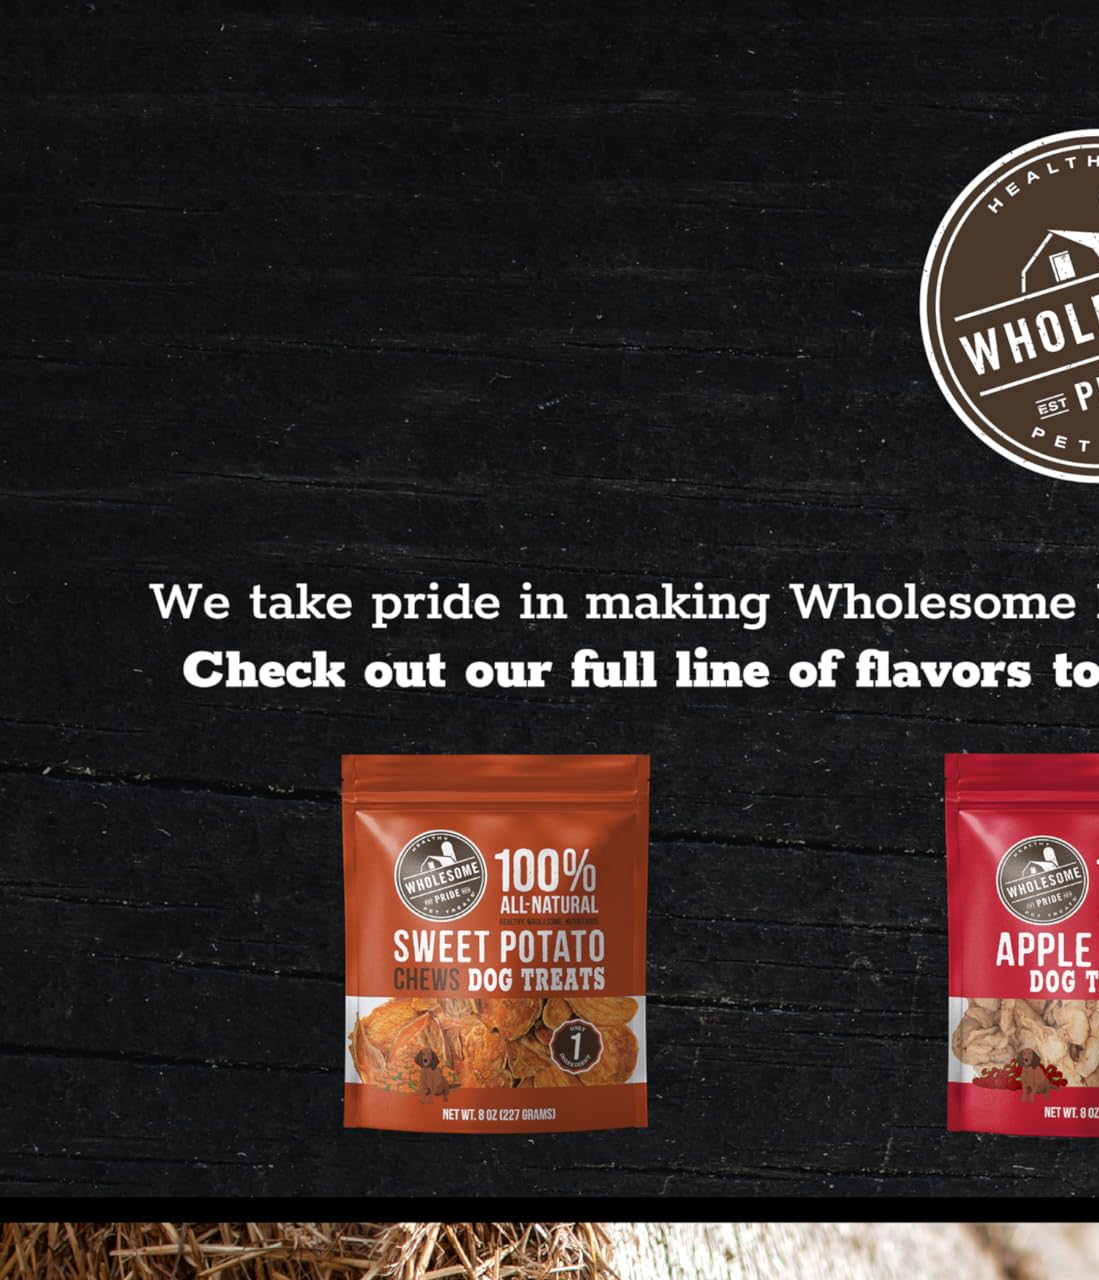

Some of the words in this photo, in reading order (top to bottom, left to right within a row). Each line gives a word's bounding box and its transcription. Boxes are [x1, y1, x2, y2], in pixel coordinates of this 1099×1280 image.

[404, 861, 480, 895] WHOLESOME
[494, 848, 597, 893] 100%
[1006, 866, 1082, 899] WHOLESOME
[433, 888, 462, 904] PRIDE
[500, 895, 599, 915] ALL-NATURAL
[1035, 892, 1063, 908] PRIDE
[393, 929, 490, 963] SWEET
[500, 929, 605, 963] POTATO
[996, 932, 1092, 967] APPLE
[393, 967, 460, 991] CHEWS
[468, 967, 513, 992] DOG
[520, 967, 606, 991] TREATS
[1029, 970, 1076, 993] DOG
[570, 1032, 582, 1060] 1
[442, 1107, 459, 1121] NET
[461, 1108, 477, 1121] WT.
[477, 1108, 485, 1121] 8
[486, 1108, 497, 1121] OZ
[499, 1108, 520, 1121] (227
[521, 1107, 556, 1120] GRAMS)
[1044, 1106, 1061, 1118] NET
[1063, 1106, 1079, 1119] WT.
[1080, 1107, 1087, 1119] 8
[1088, 1107, 1099, 1119] OZ
